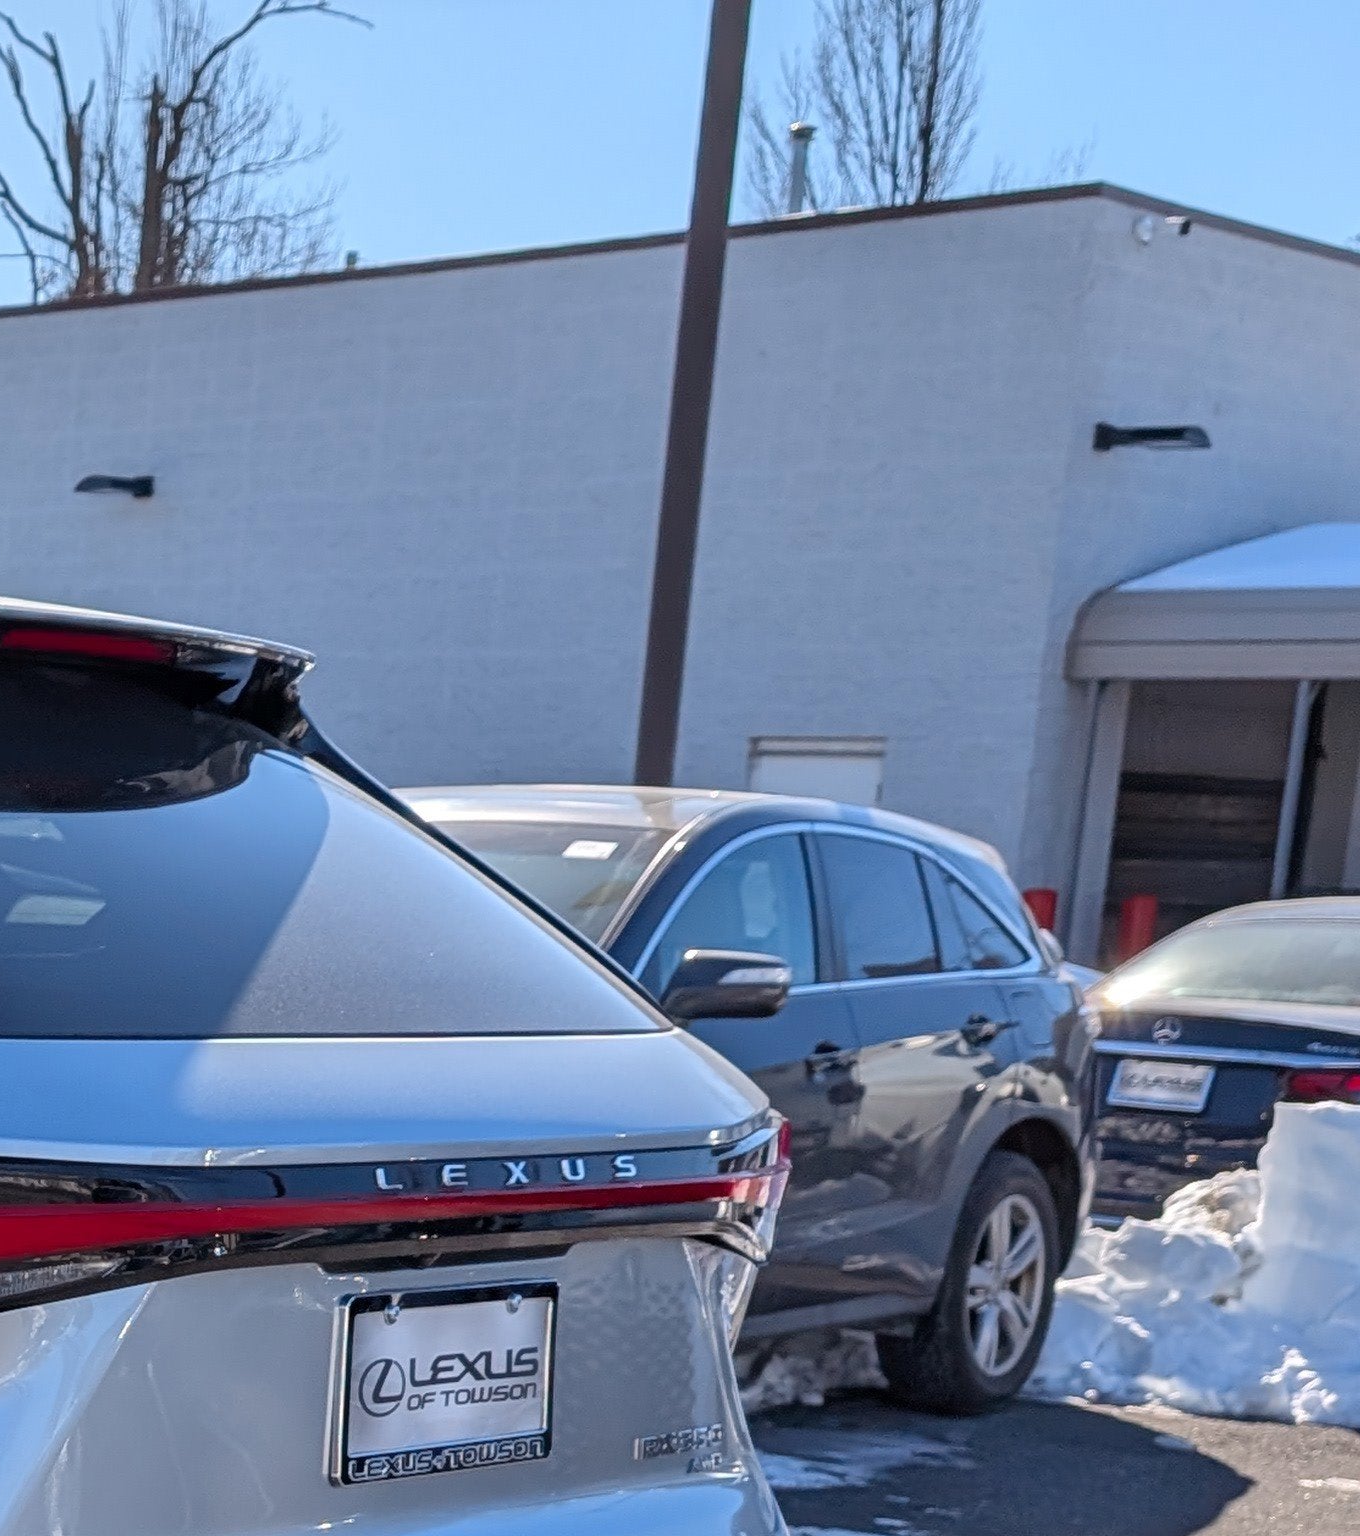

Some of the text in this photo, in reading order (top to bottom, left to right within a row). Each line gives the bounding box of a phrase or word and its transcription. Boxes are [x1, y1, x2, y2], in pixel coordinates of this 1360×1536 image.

[375, 1155, 638, 1190] LEXUS
[409, 1347, 539, 1388] LEXUS
[407, 1382, 537, 1411] OF TOWSON
[348, 1450, 434, 1482] LEXUS
[442, 1436, 546, 1470] TOWSON
